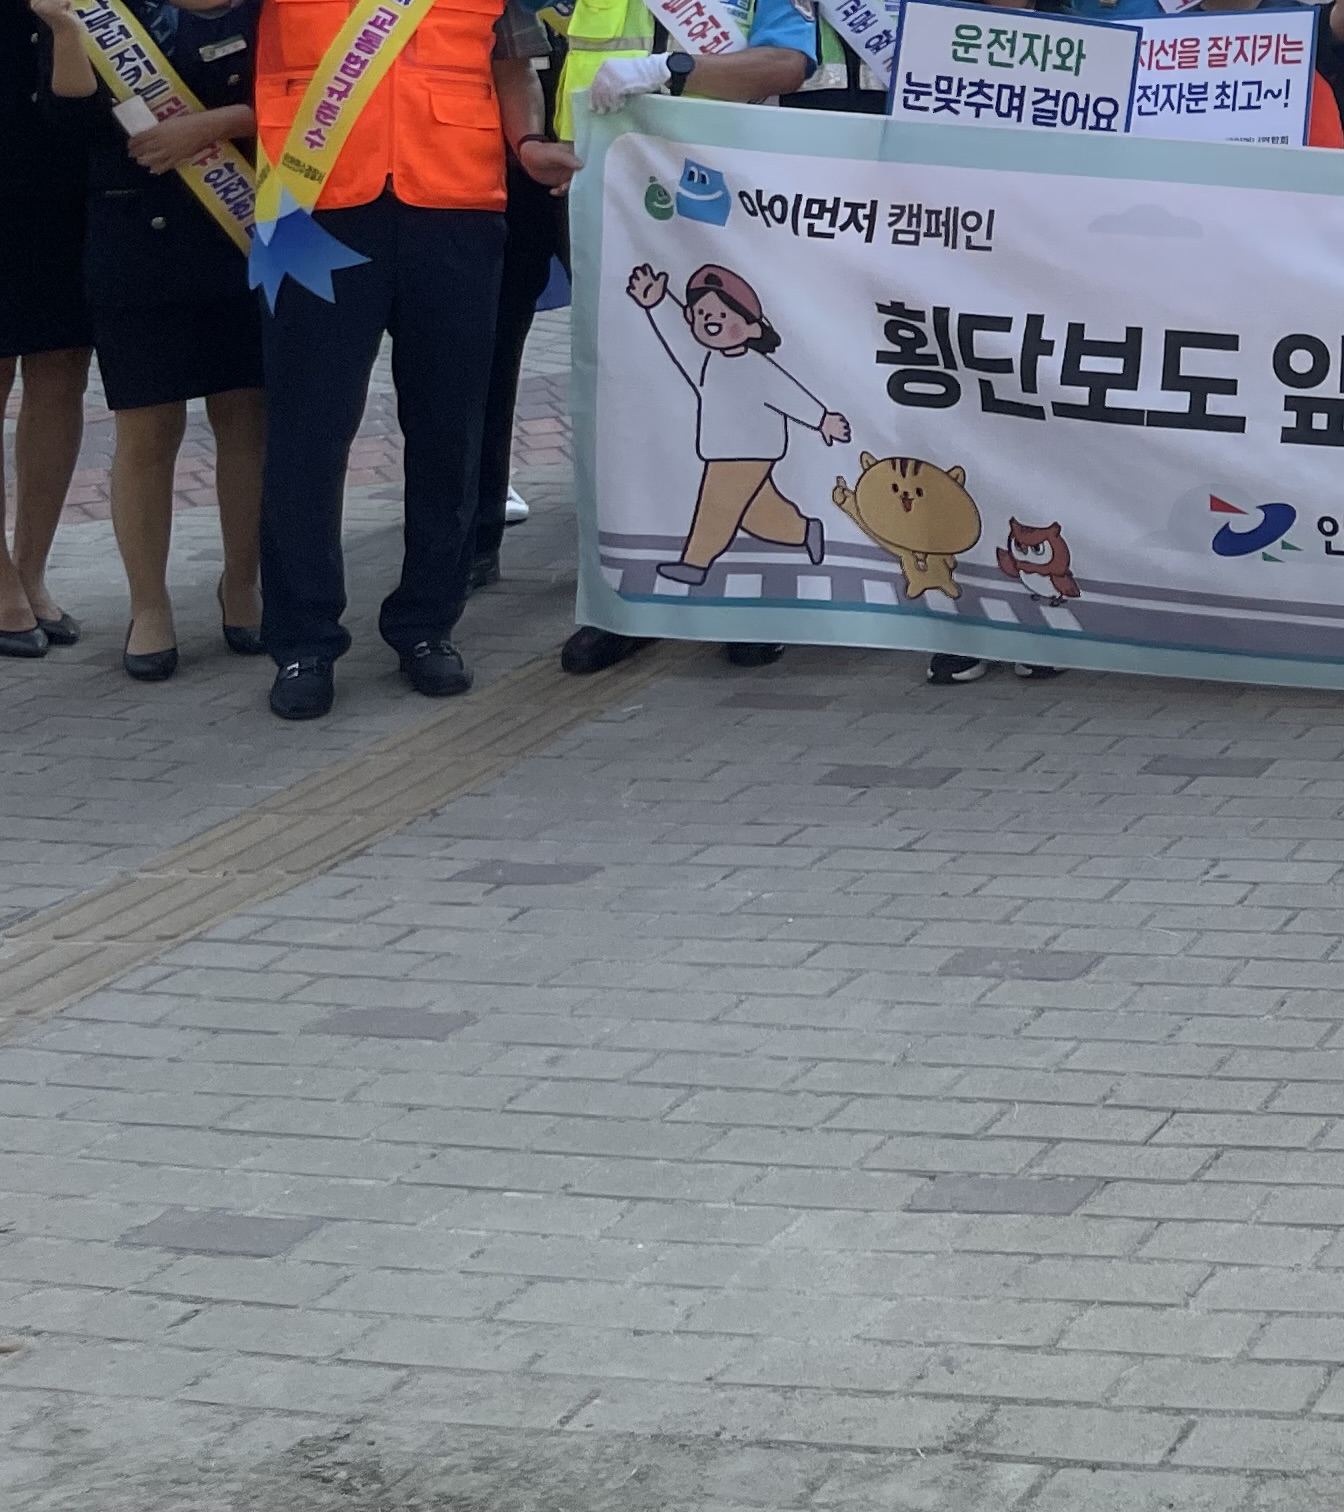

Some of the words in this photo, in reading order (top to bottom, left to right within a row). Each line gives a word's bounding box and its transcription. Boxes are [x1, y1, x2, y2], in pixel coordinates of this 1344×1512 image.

[304, 6, 400, 150] 교통법규준수
[950, 23, 1087, 77] 운전자와
[1139, 35, 1201, 71] 지선을
[902, 71, 1027, 123] 눈맞추며
[1031, 88, 1120, 133] 걸어요
[1136, 80, 1211, 117] 전자분
[738, 189, 878, 243] 아이먼저
[887, 203, 995, 252] 캠페인
[874, 301, 1247, 435] 횡단보도
